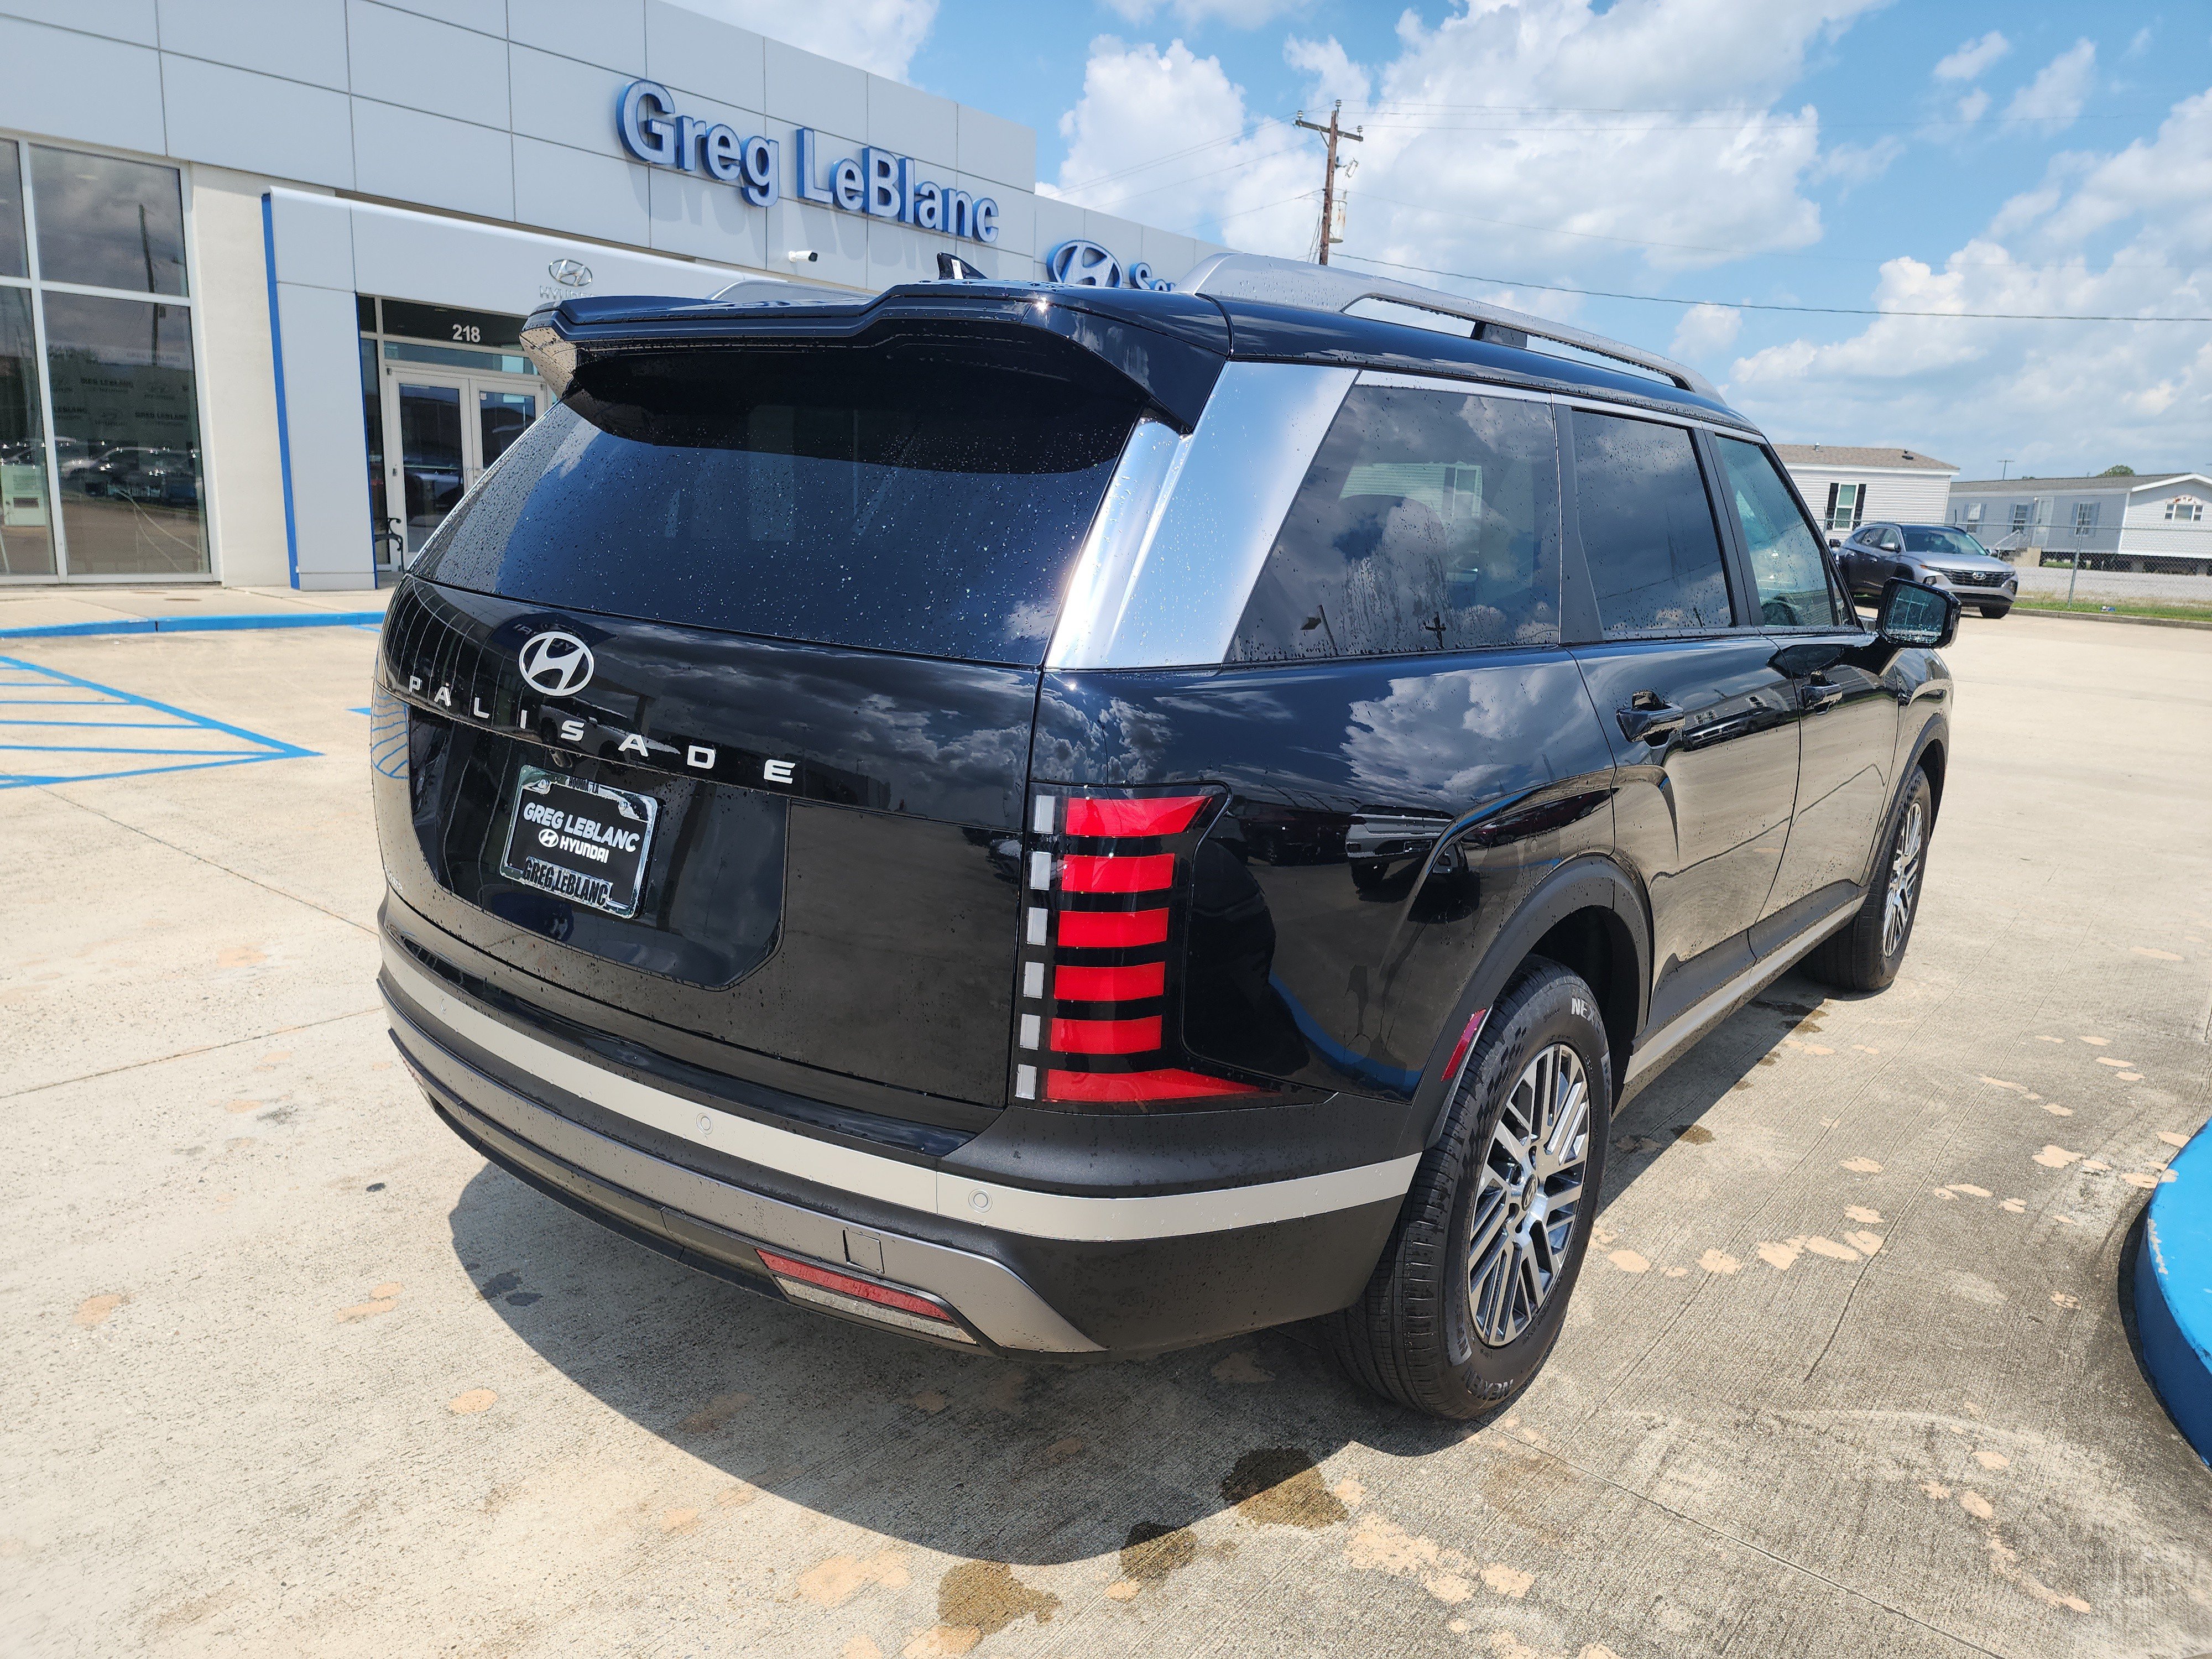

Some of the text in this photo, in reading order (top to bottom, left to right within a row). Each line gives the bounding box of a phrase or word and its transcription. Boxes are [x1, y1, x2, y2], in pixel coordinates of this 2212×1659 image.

[617, 80, 999, 242] Greg LeBlanc
[452, 324, 481, 342] 218
[409, 675, 796, 784] PALISADE
[523, 802, 640, 852] GREG LEBLANC
[559, 835, 609, 864] HYUNDAI
[525, 859, 555, 888] GREG
